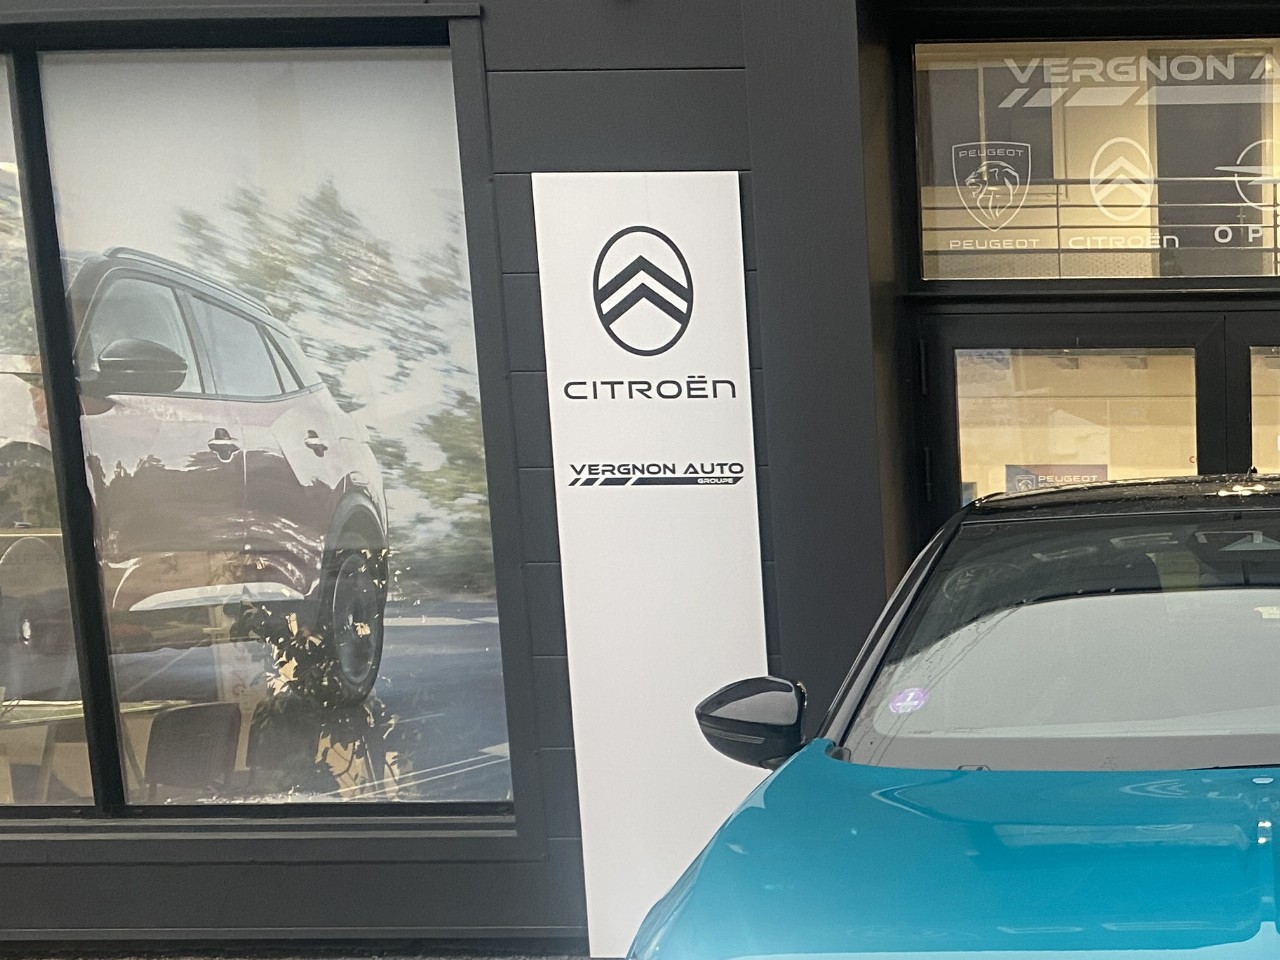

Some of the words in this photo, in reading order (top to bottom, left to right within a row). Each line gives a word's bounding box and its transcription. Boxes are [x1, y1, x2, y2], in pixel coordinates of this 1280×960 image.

[1006, 54, 1236, 84] VERGNON
[958, 148, 1025, 158] PEUGEOT
[949, 238, 1041, 250] PEUGEOT
[563, 375, 737, 400] CITROËN
[569, 462, 677, 476] VERGNON
[683, 462, 745, 475] AUTO
[1038, 475, 1099, 483] PEUGEOT
